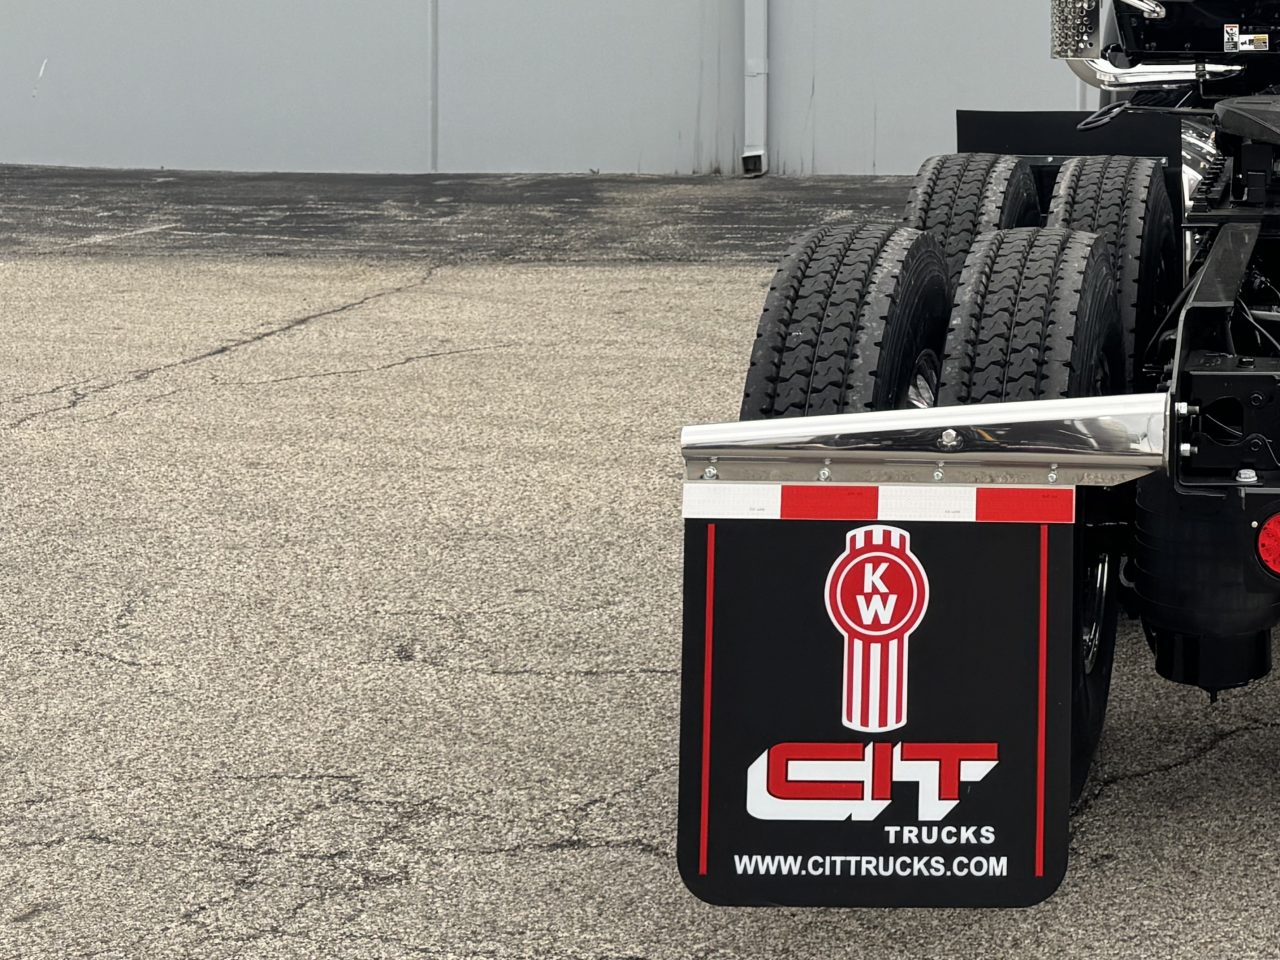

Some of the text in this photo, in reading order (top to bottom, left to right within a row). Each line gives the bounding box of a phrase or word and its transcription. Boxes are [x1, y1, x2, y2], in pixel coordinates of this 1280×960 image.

[746, 741, 999, 821] CIT
[884, 825, 996, 845] TRUCKS
[734, 854, 1009, 877] WWW.CITTRUCKS.COM
